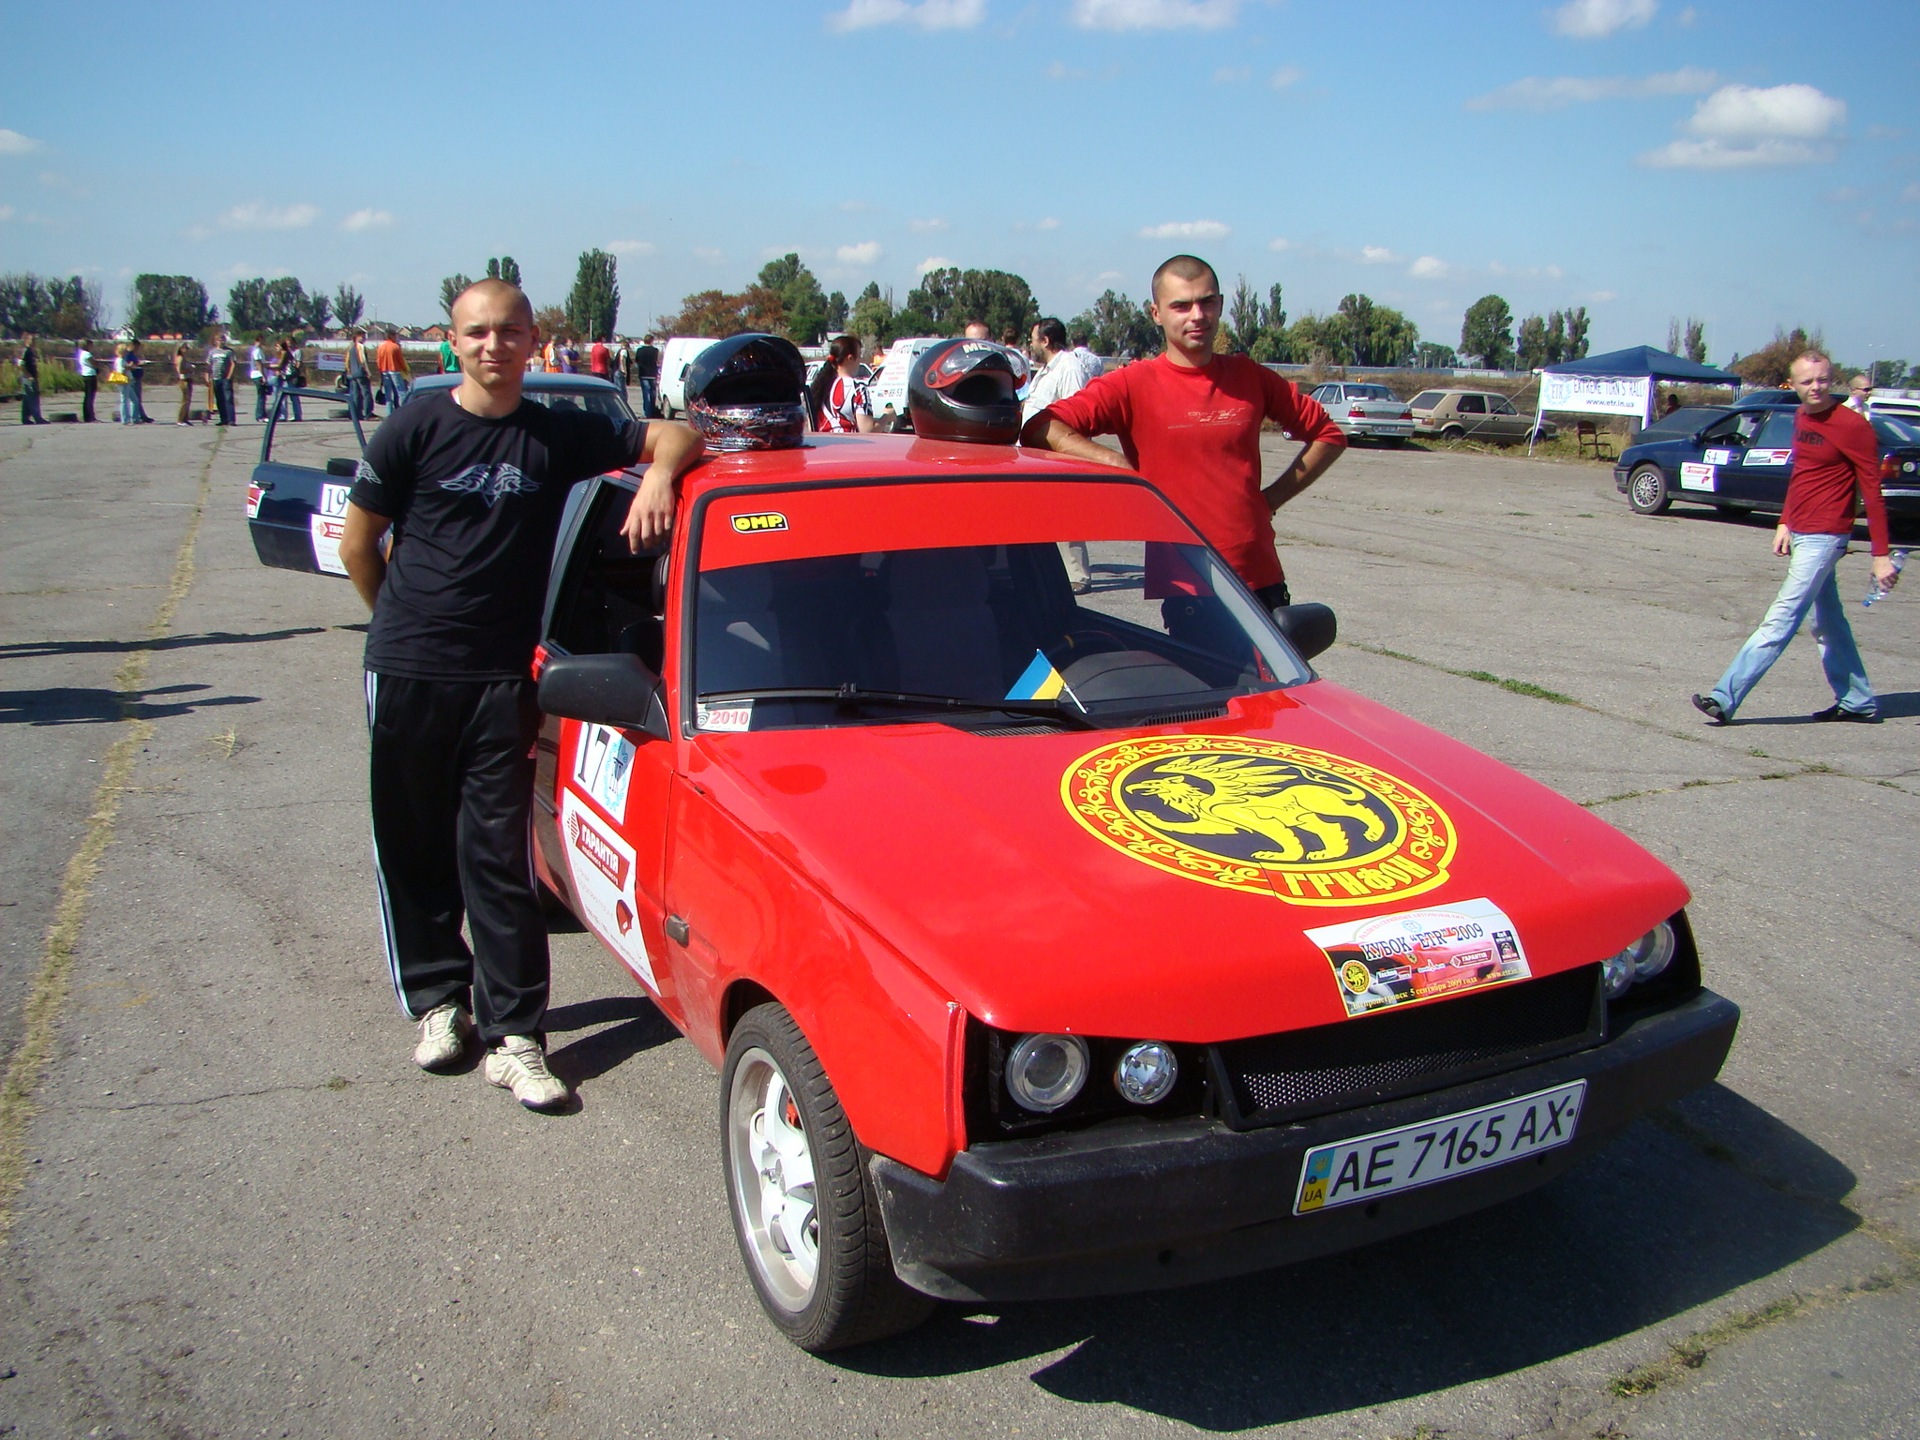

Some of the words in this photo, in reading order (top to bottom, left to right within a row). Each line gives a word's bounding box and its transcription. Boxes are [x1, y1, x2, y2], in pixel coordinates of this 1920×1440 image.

[1585, 398, 1635, 409] www.etr.in.ua
[710, 711, 749, 725] 2010
[582, 823, 619, 875] ГАРАНТІЯ
[1282, 854, 1434, 897] ГРИФОН
[1361, 936, 1412, 960] КУБОК
[1451, 922, 1484, 941] 2009
[1410, 988, 1416, 997] 5
[1416, 981, 1447, 997] сентября
[1448, 978, 1462, 988] 2009
[1463, 976, 1478, 986] года
[1330, 1141, 1399, 1197] AE
[1408, 1114, 1505, 1179] 7165
[1511, 1094, 1572, 1151] AX
[1304, 1188, 1323, 1203] UA
